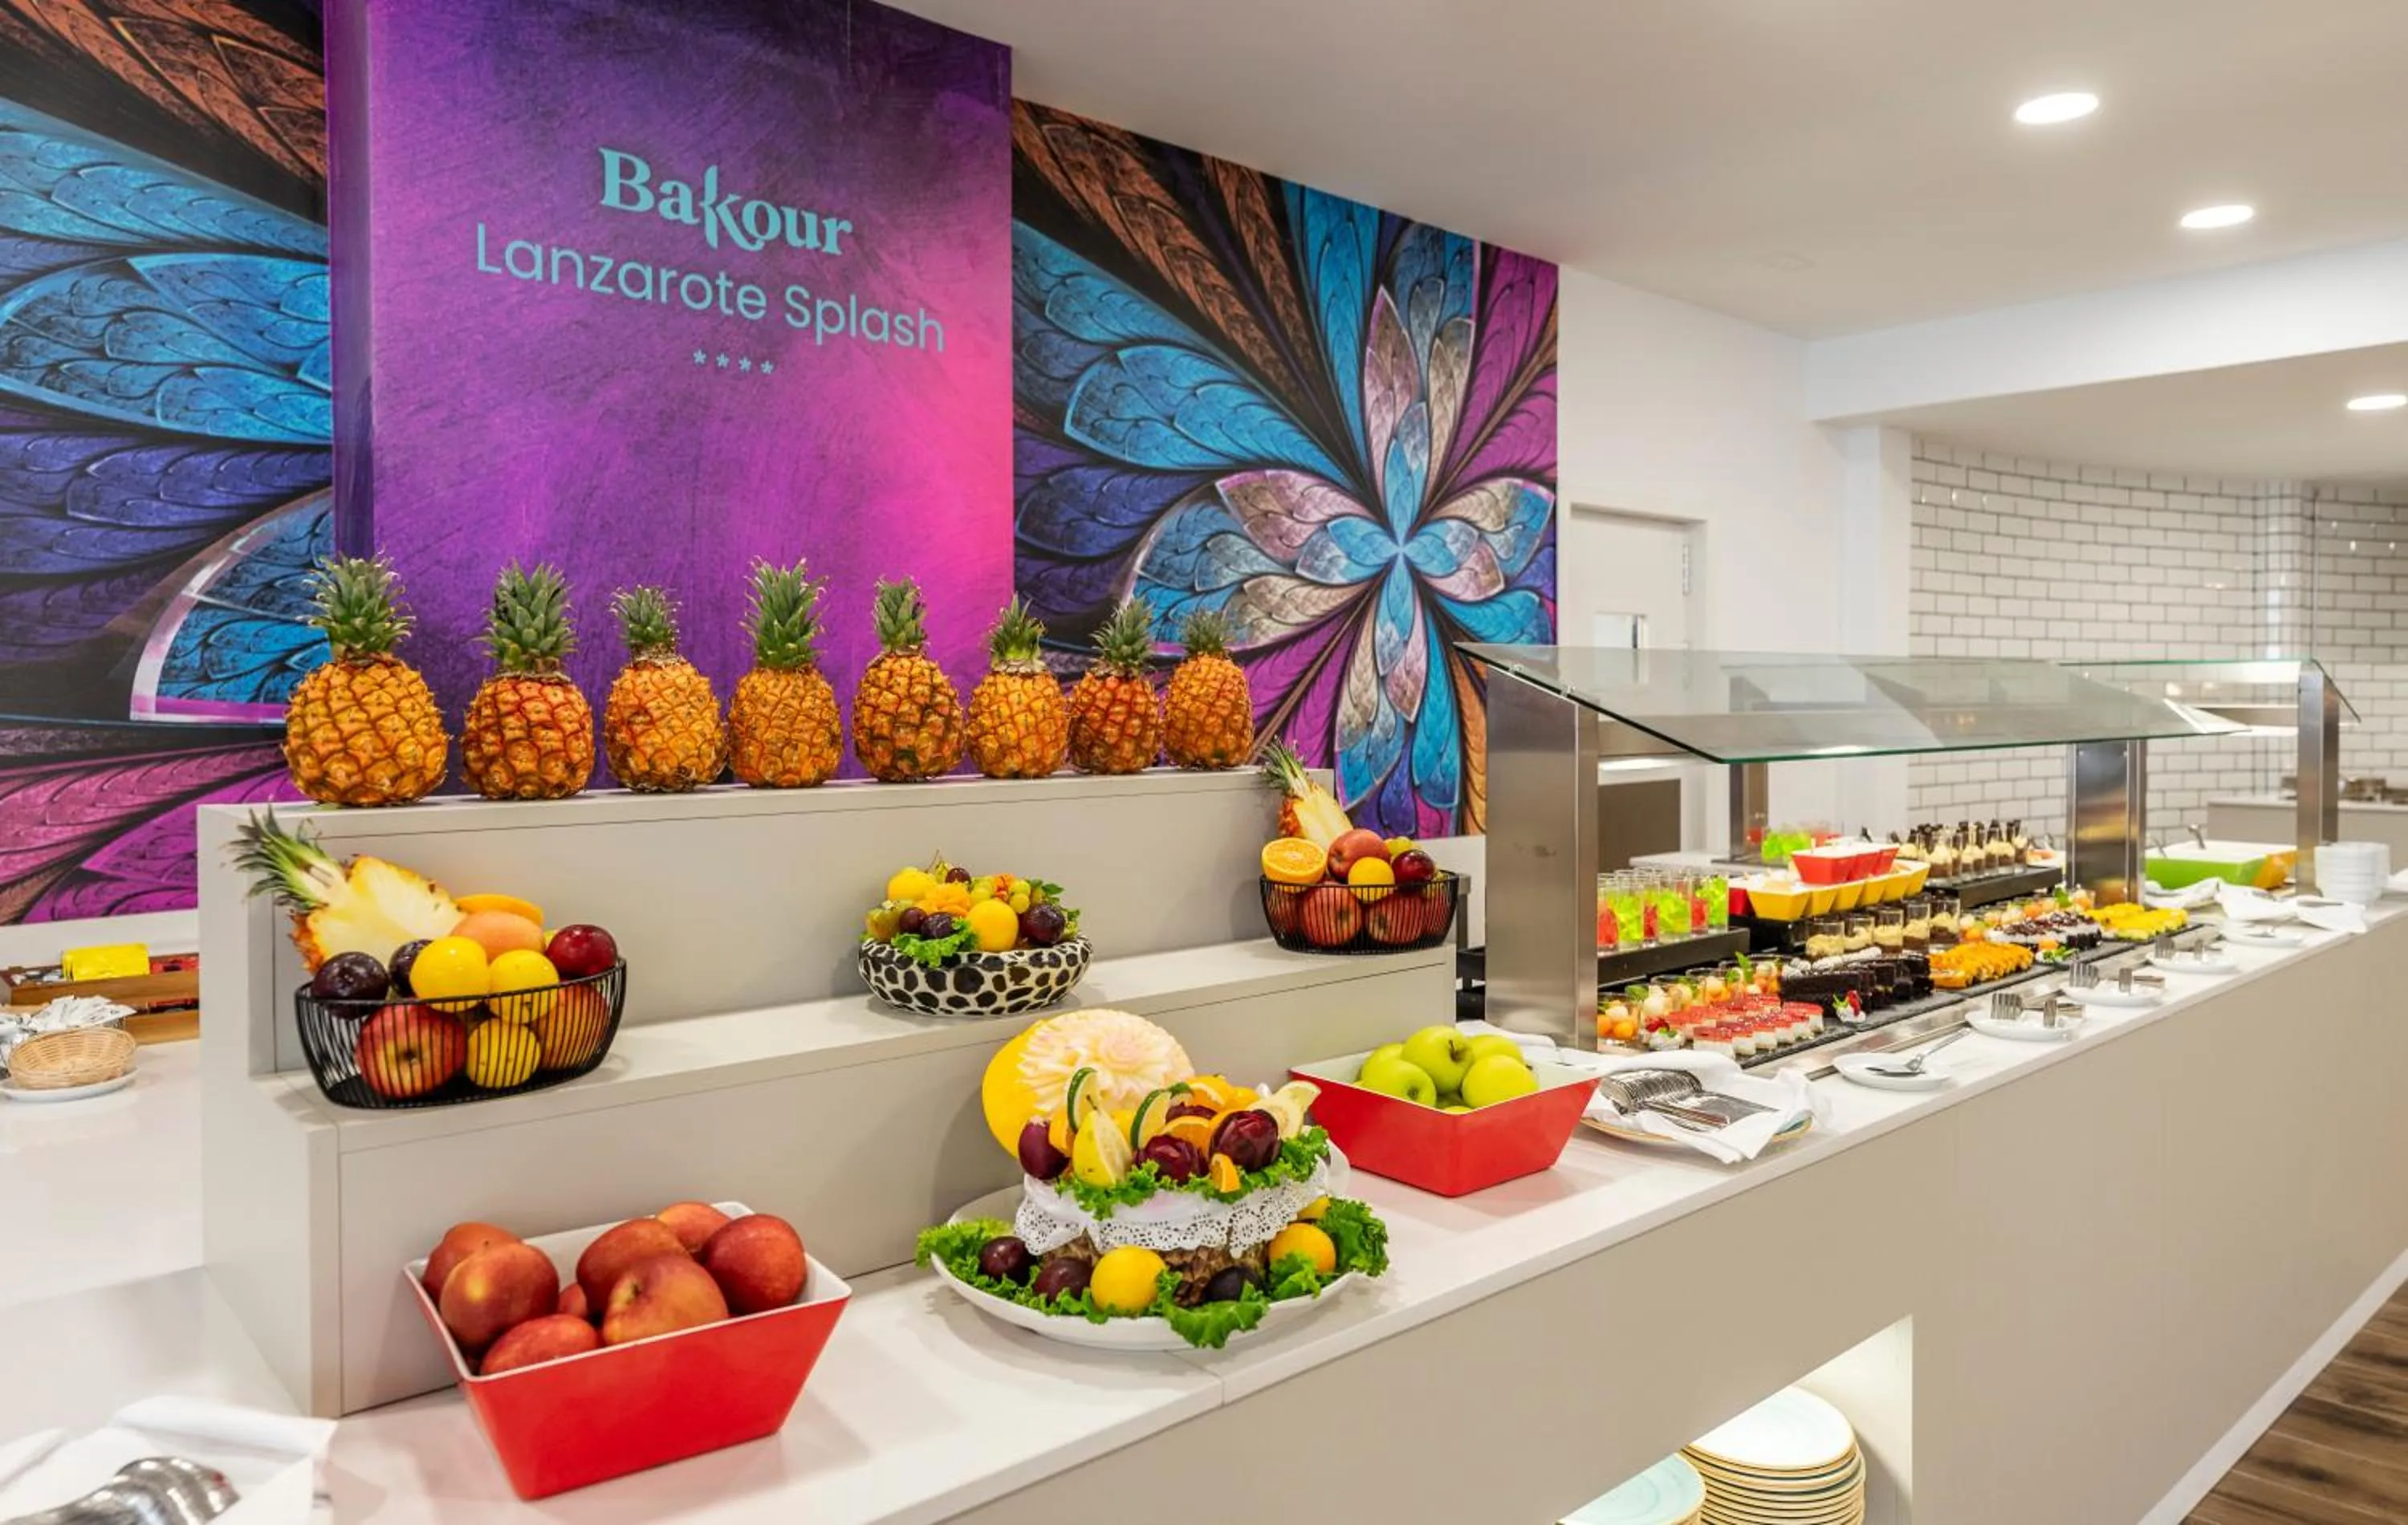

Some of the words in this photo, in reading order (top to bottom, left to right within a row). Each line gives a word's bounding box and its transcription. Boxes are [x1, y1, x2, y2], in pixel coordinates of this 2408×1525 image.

[599, 148, 852, 255] Bakour
[477, 222, 767, 319] Lanzarote
[785, 285, 945, 352] Splash
